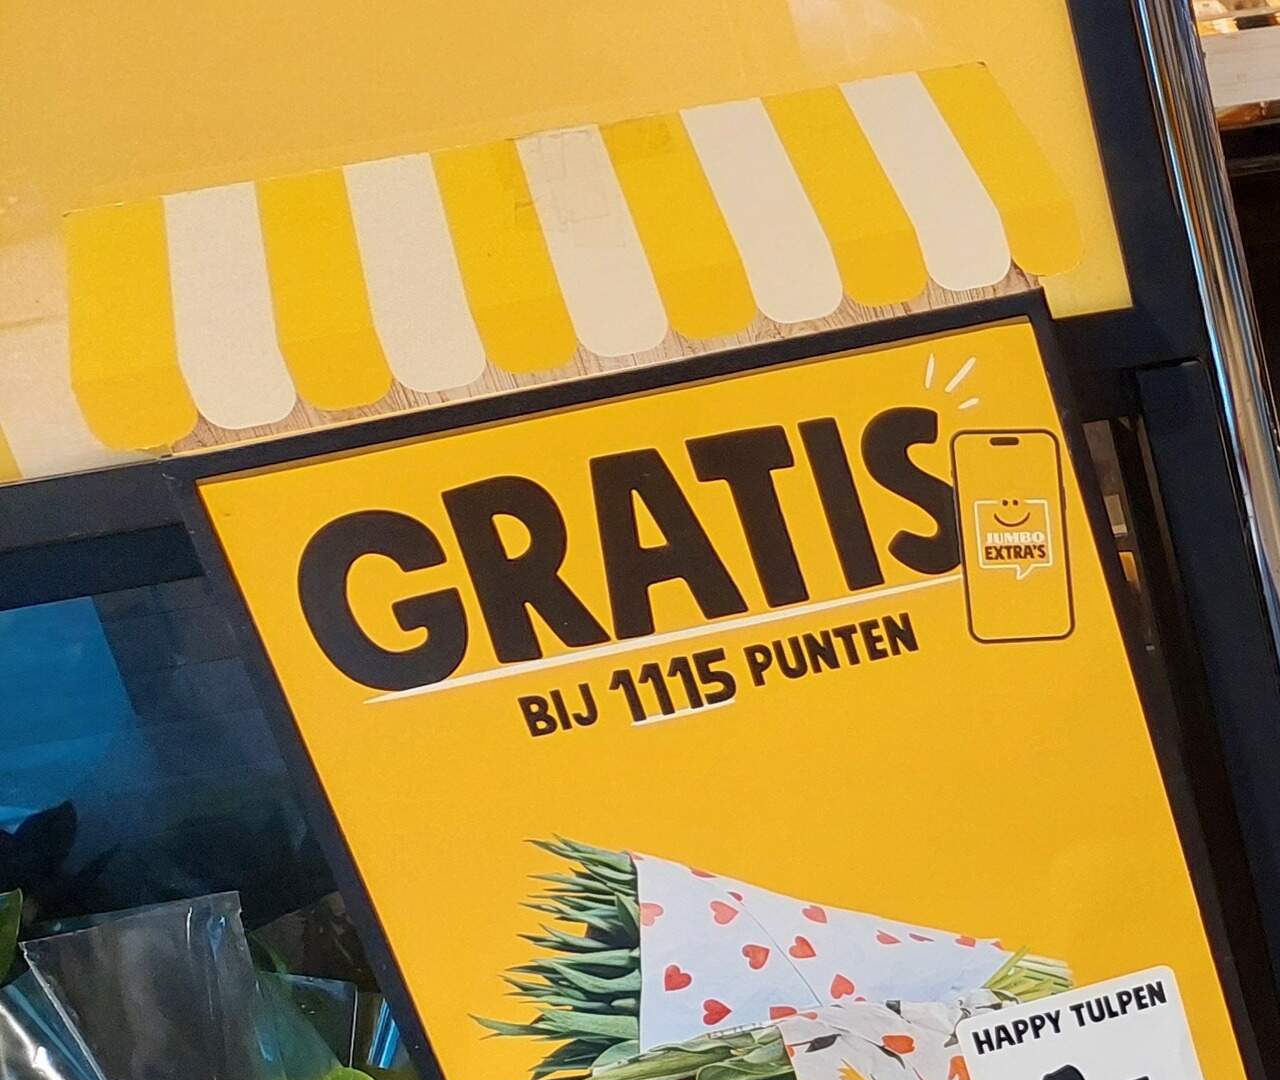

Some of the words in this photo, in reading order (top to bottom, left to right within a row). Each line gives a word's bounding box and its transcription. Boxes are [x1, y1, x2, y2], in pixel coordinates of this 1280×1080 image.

[296, 407, 963, 691] GRATIS
[984, 545, 1046, 560] EXTRA'S
[985, 531, 1045, 544] JUMBO
[520, 683, 598, 737] BIJ
[608, 648, 736, 722] 1115
[746, 612, 919, 688] PUNTEN
[972, 1010, 1061, 1054] HAPPY
[1070, 981, 1167, 1028] TULPEN
